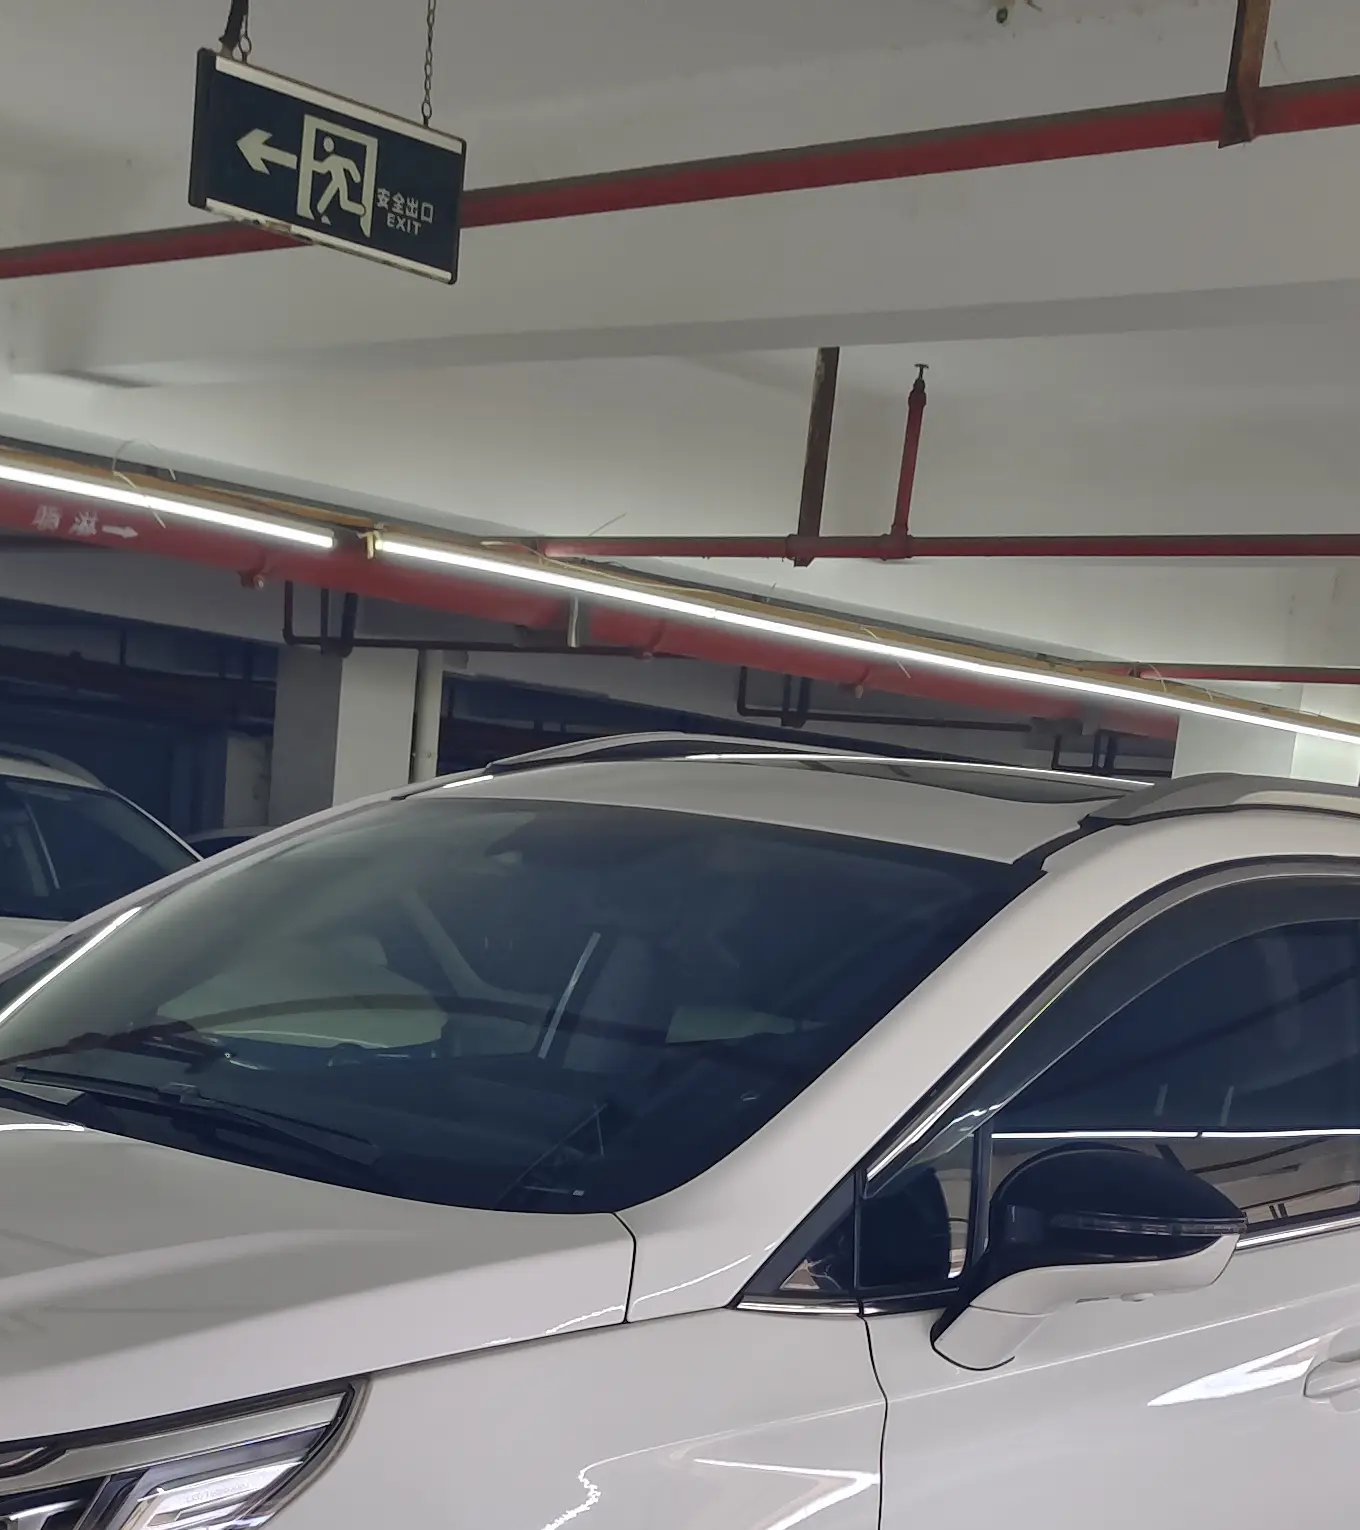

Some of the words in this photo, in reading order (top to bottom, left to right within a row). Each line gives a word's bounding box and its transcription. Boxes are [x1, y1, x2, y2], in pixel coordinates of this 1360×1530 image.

[376, 187, 434, 224] 安全出口
[386, 212, 422, 236] EXIT
